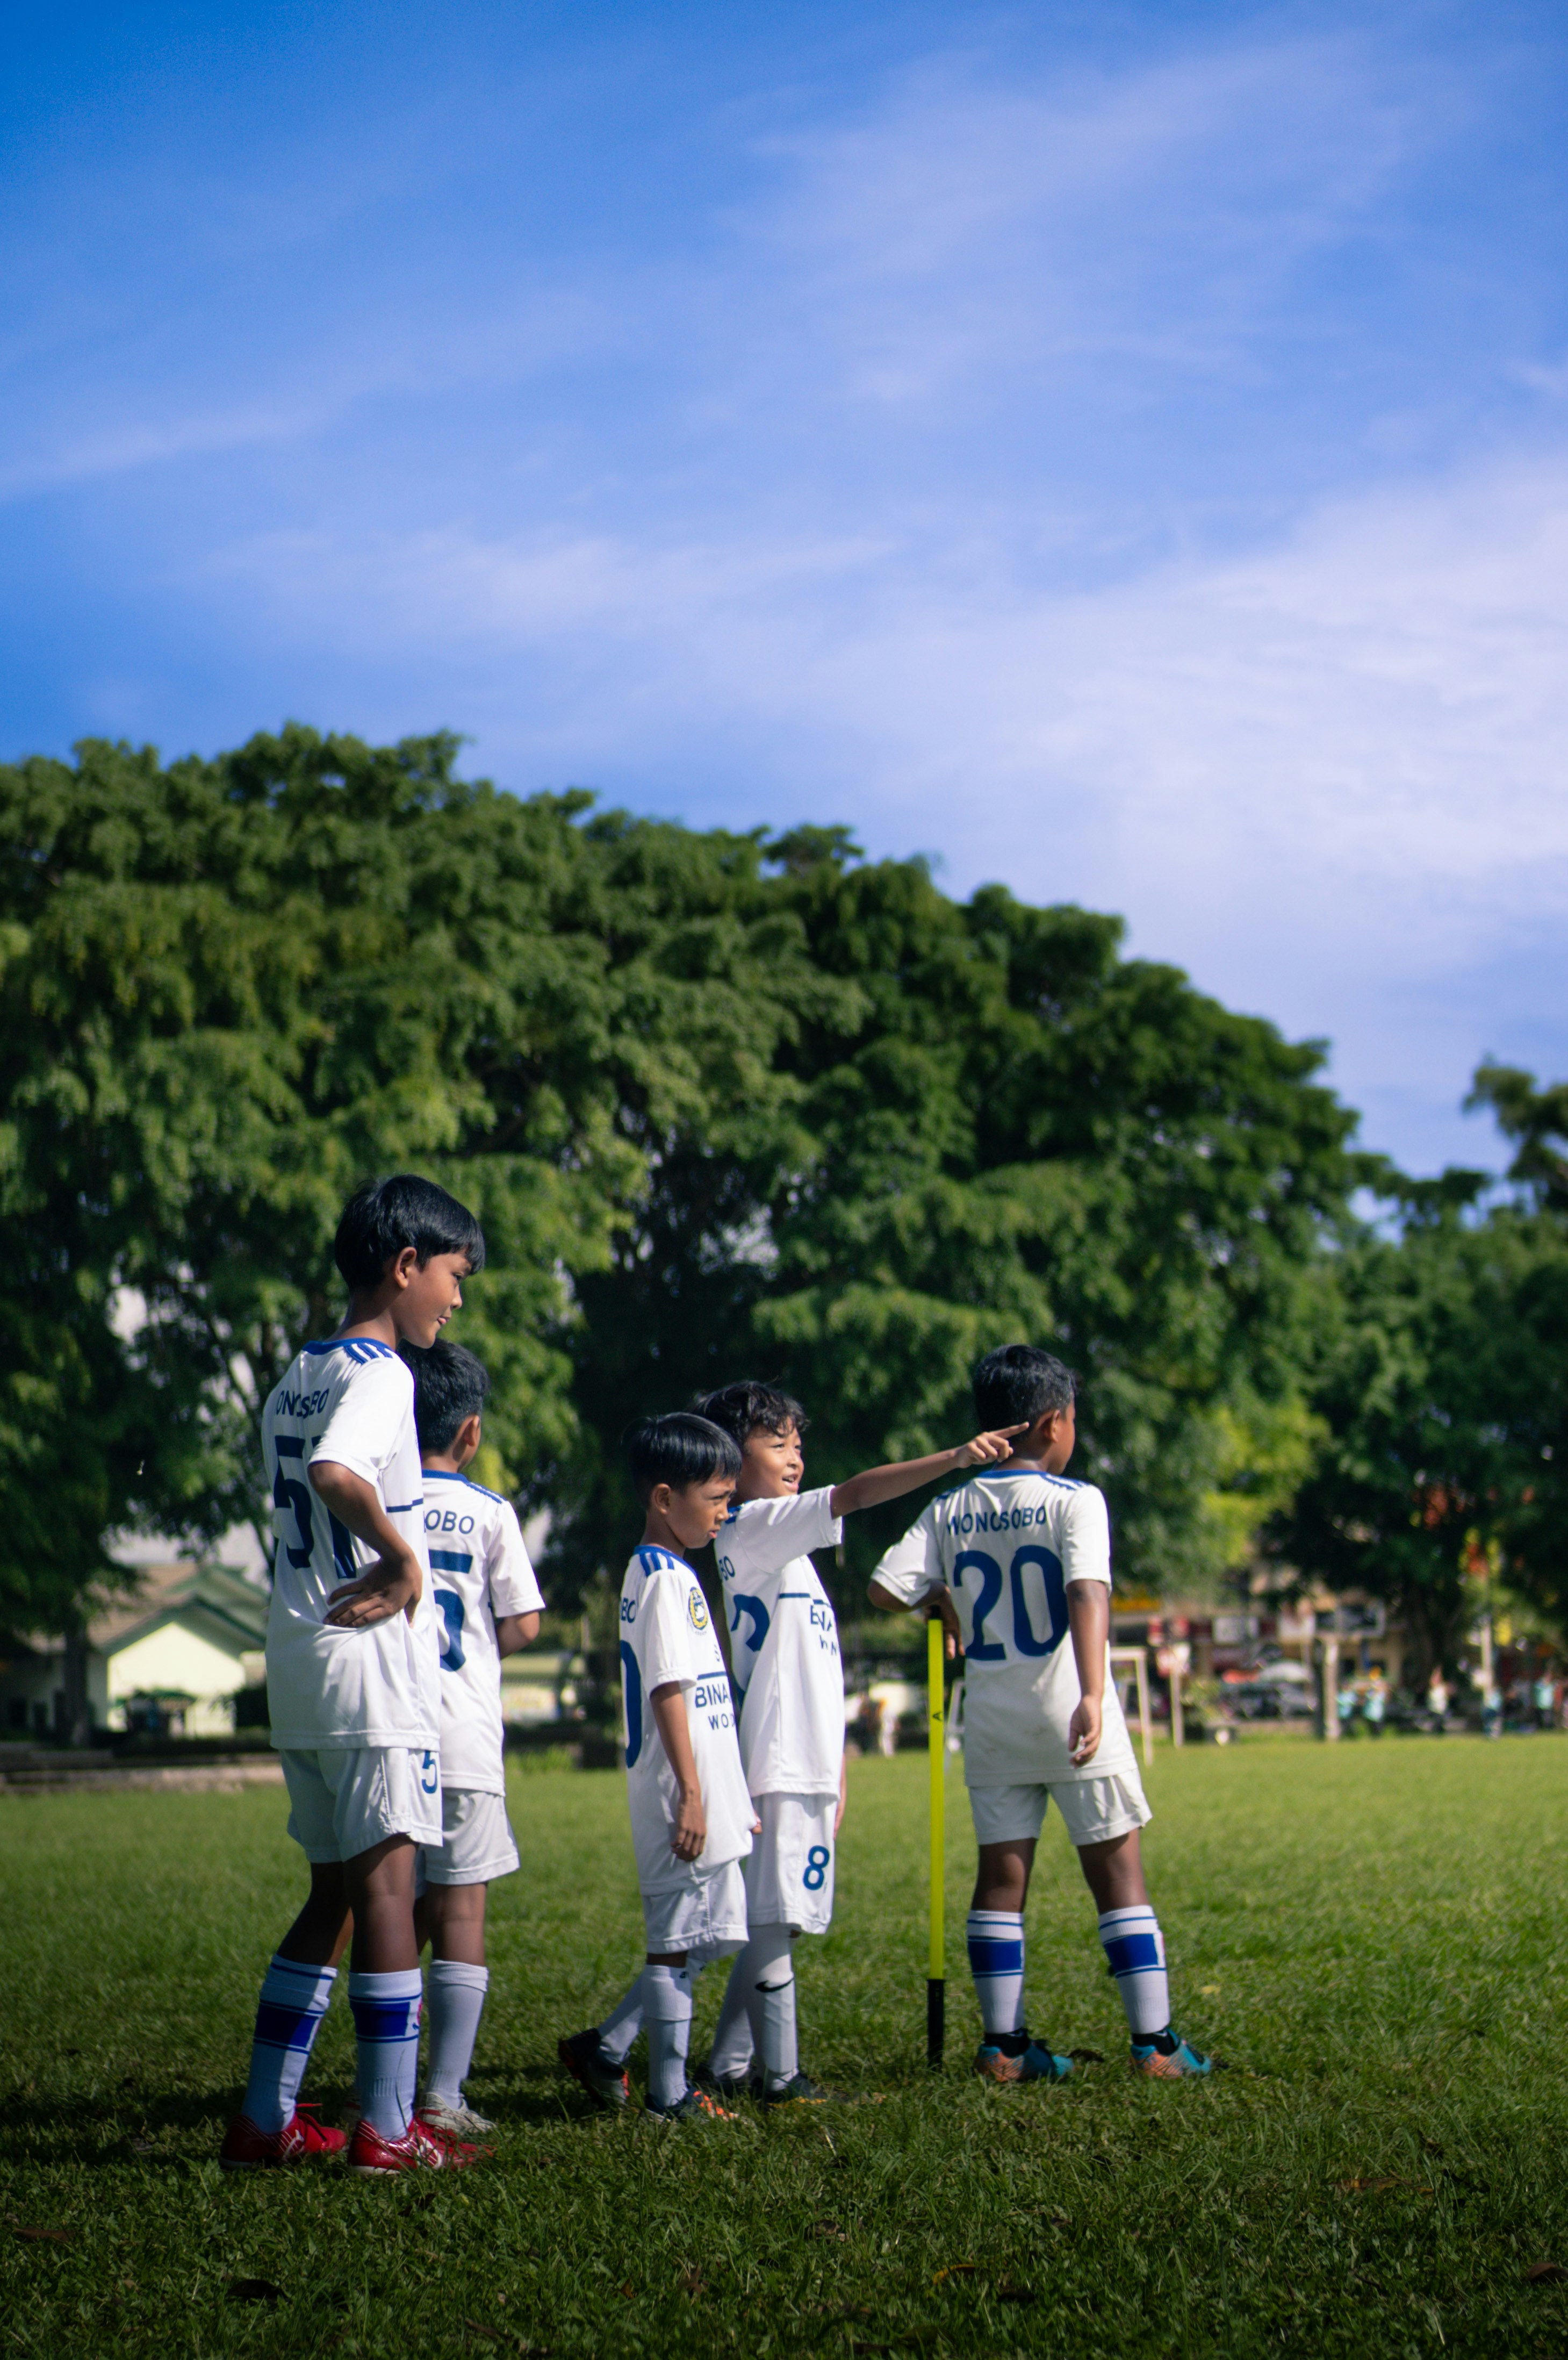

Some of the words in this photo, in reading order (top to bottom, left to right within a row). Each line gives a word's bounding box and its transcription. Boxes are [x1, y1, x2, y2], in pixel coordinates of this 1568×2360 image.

[423, 1509, 475, 1534] OBO
[953, 1544, 1069, 1661] 20
[421, 1749, 438, 1794] 5
[802, 1845, 830, 1891] 8
